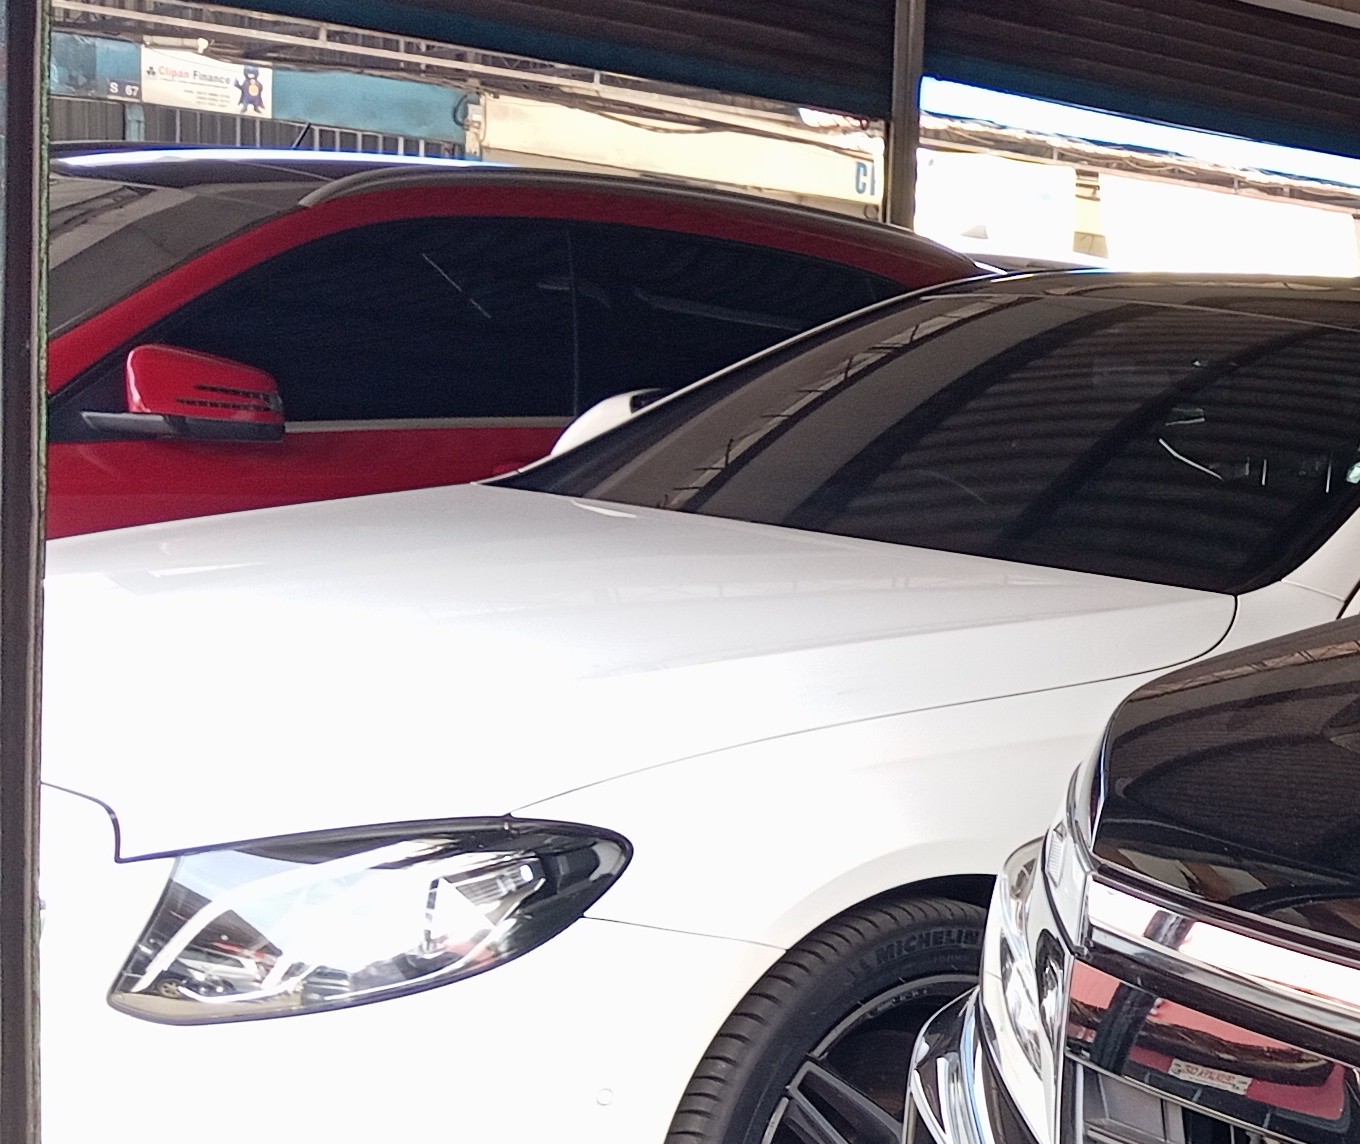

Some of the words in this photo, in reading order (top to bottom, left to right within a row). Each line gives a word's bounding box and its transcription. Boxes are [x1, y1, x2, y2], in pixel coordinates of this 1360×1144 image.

[158, 66, 190, 79] Clipan
[192, 69, 231, 85] Finance
[110, 81, 119, 94] S
[125, 84, 139, 97] 67
[874, 928, 982, 966] MICHELIN
